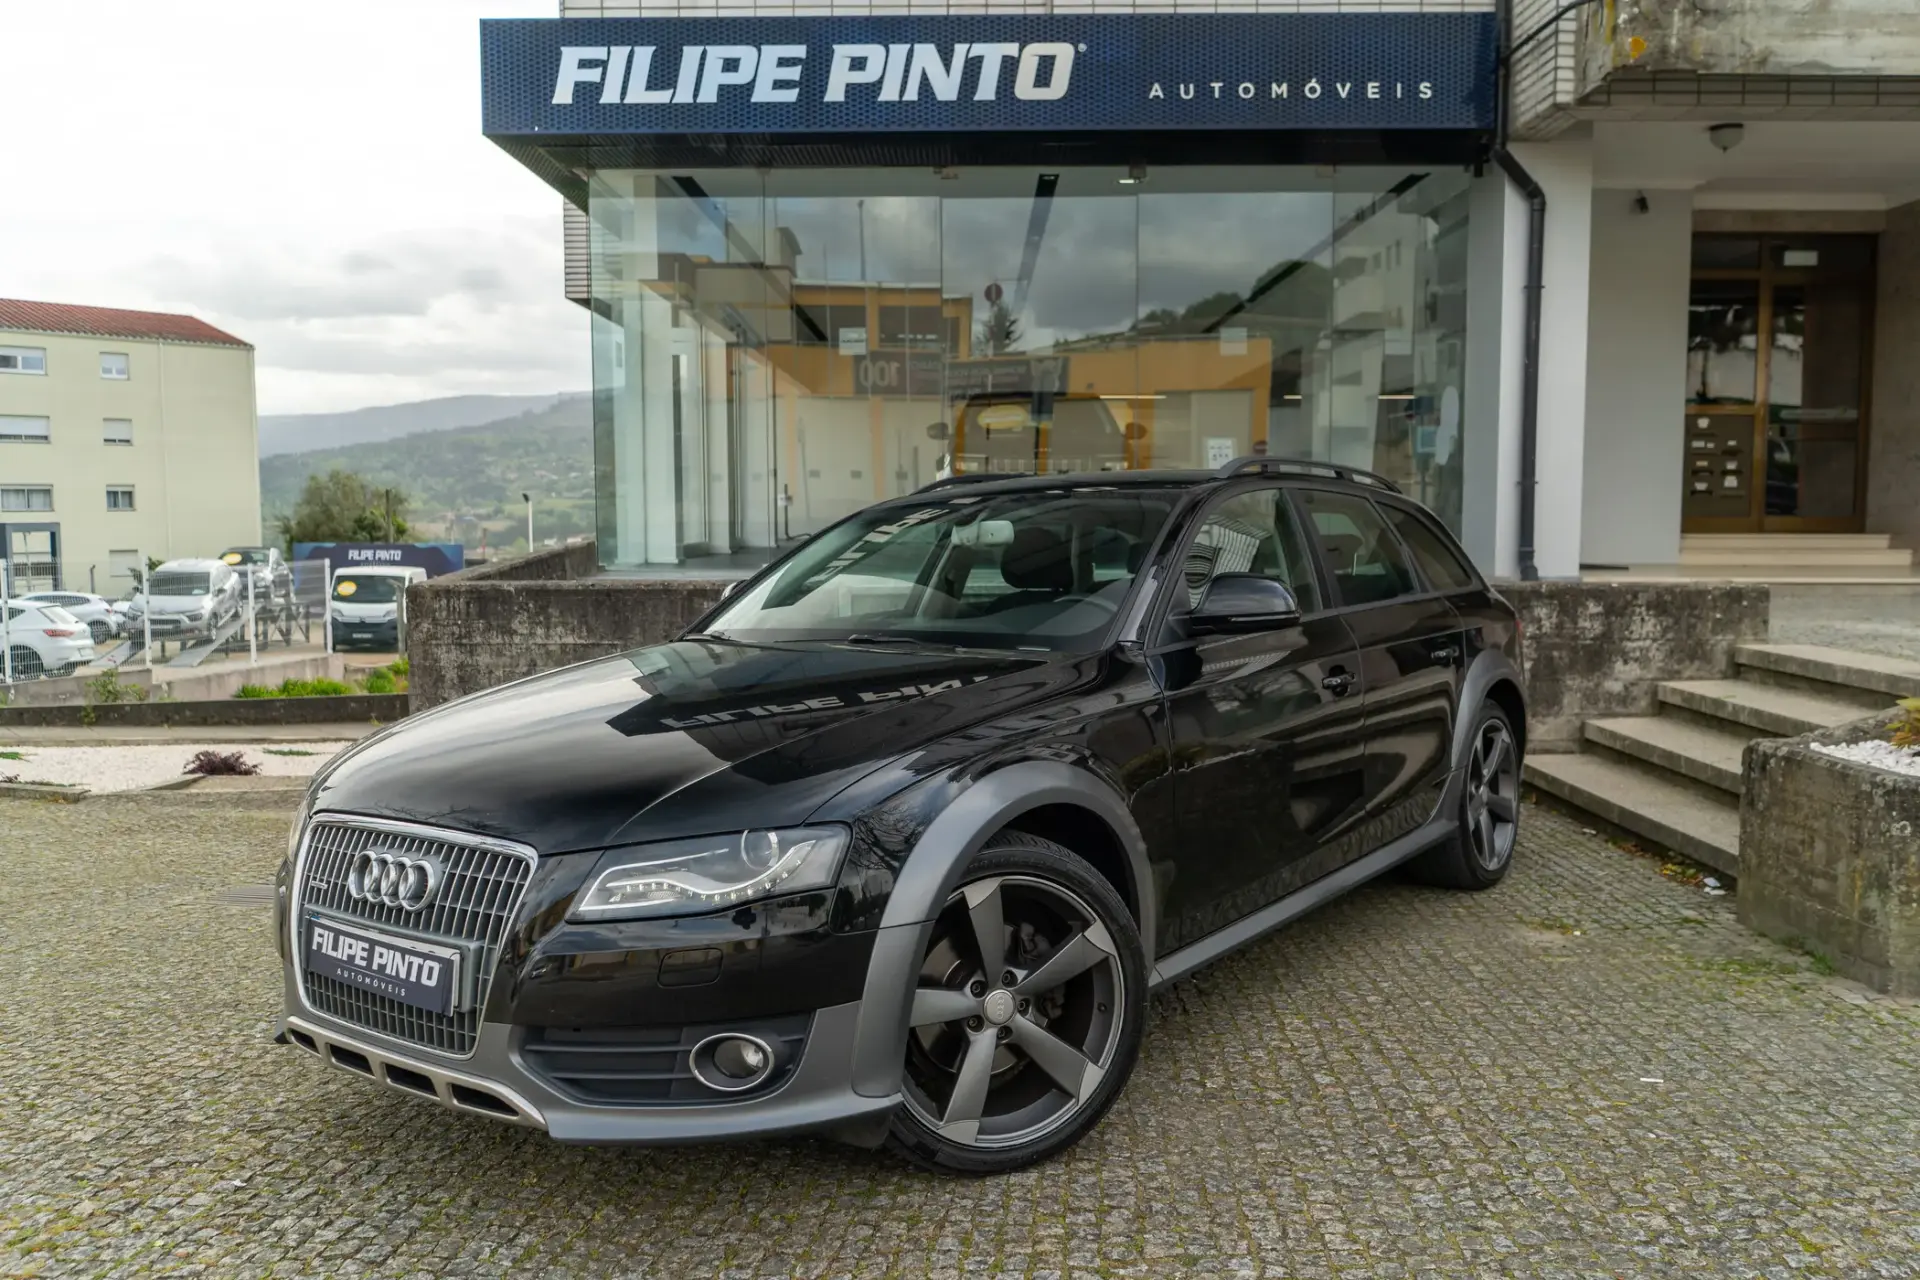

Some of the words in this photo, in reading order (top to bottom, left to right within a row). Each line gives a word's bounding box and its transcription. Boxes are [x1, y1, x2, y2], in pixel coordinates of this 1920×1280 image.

[552, 45, 806, 104] FILIPE
[824, 42, 1076, 101] PINTO
[1149, 78, 1432, 99] AUTOMÓVEIS
[348, 549, 374, 561] FILIPE
[375, 549, 402, 561] PINTO
[311, 927, 368, 967] FILIPE
[372, 945, 440, 987] PINTO
[336, 969, 406, 996] AUTOMÓVEIS
